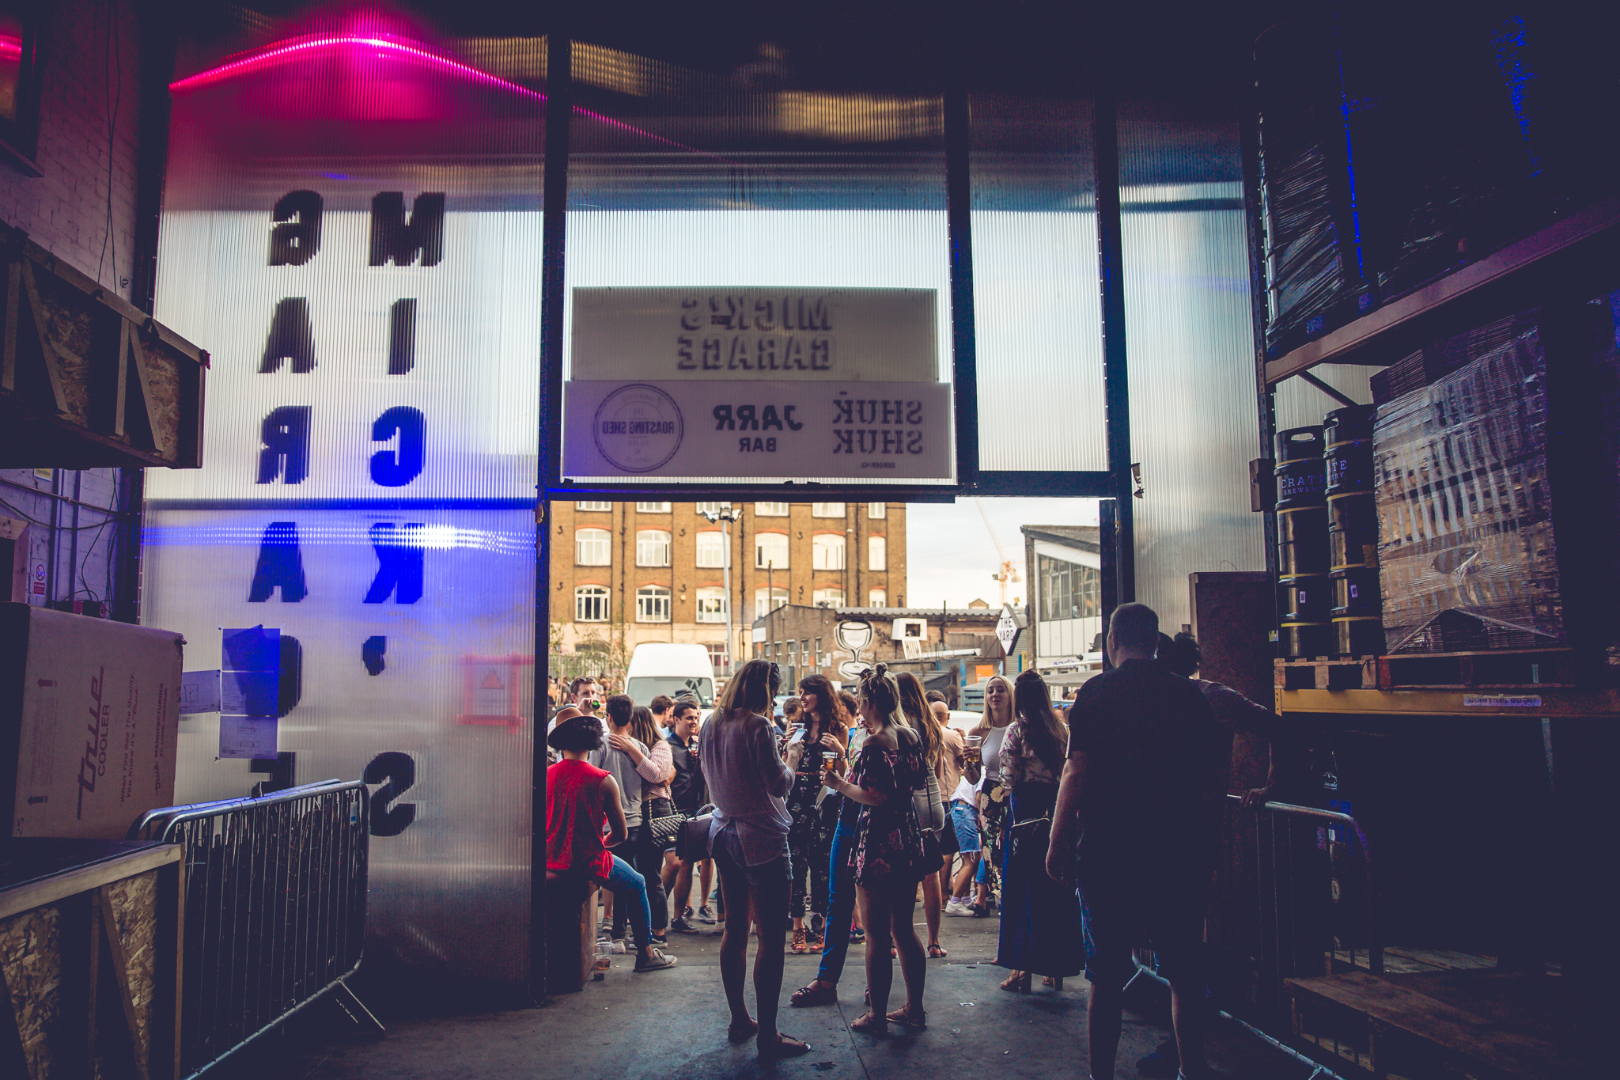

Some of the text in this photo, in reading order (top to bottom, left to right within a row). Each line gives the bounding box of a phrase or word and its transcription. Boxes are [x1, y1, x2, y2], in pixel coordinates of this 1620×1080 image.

[1280, 474, 1327, 489] CRATE
[999, 616, 1012, 628] THE
[999, 629, 1014, 642] YARD
[97, 704, 110, 777] COOLER
[154, 682, 164, 758] MANUFACTURING
[76, 664, 104, 821] true
